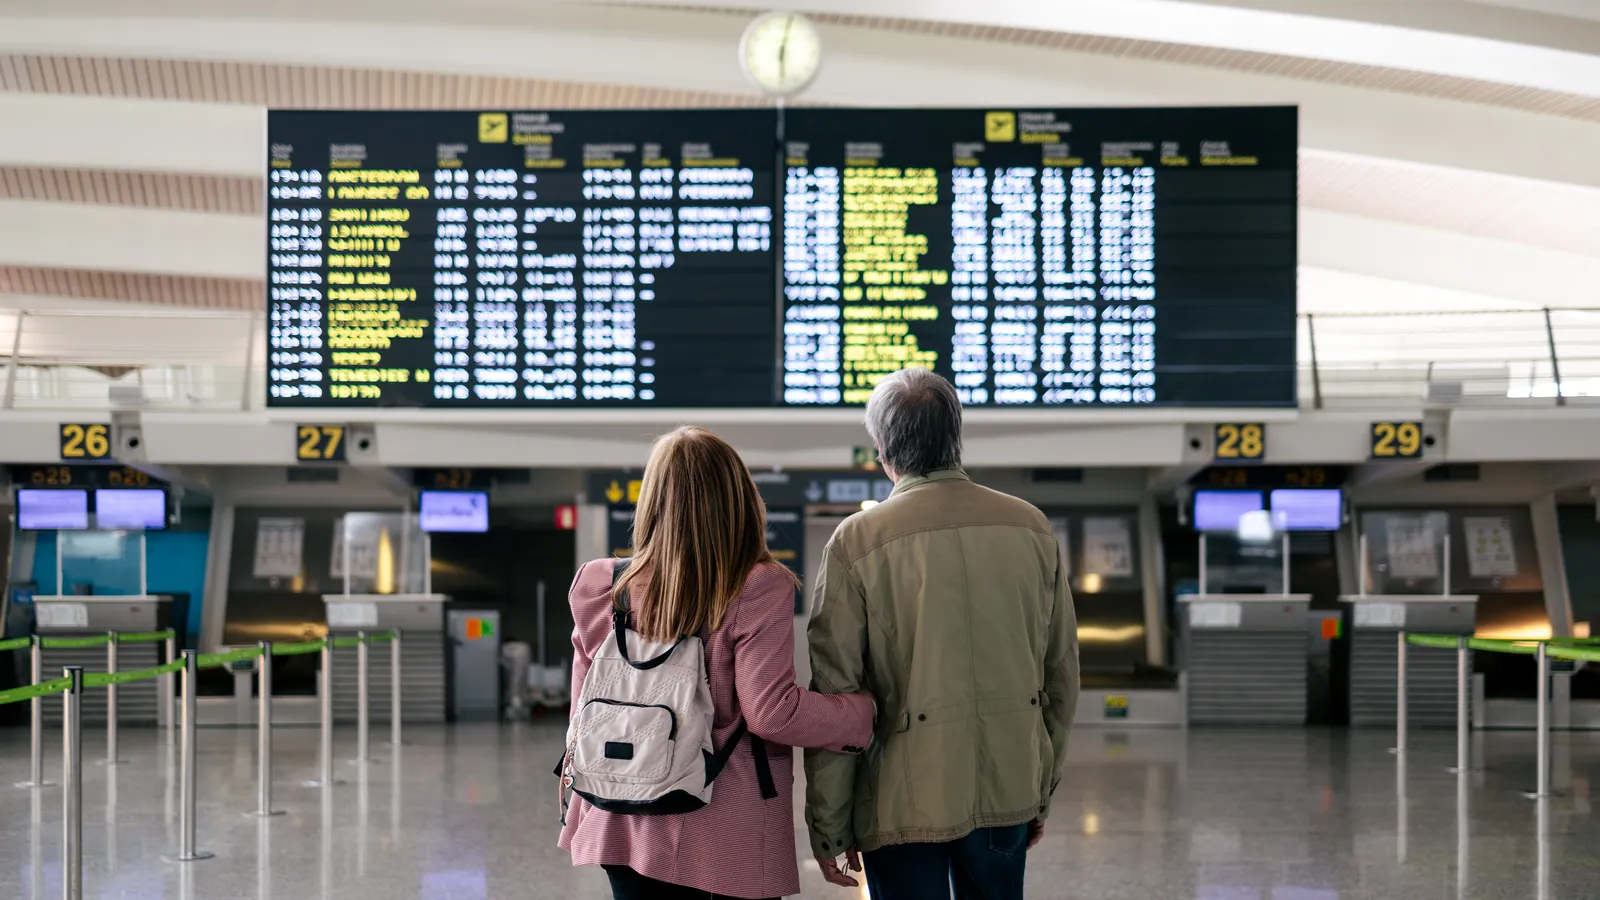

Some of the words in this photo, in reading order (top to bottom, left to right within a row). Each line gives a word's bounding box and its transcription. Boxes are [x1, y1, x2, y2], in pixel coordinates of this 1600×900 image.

[62, 424, 109, 457] 26
[298, 427, 343, 459] 27
[1216, 424, 1263, 457] 28
[1373, 422, 1421, 456] 29
